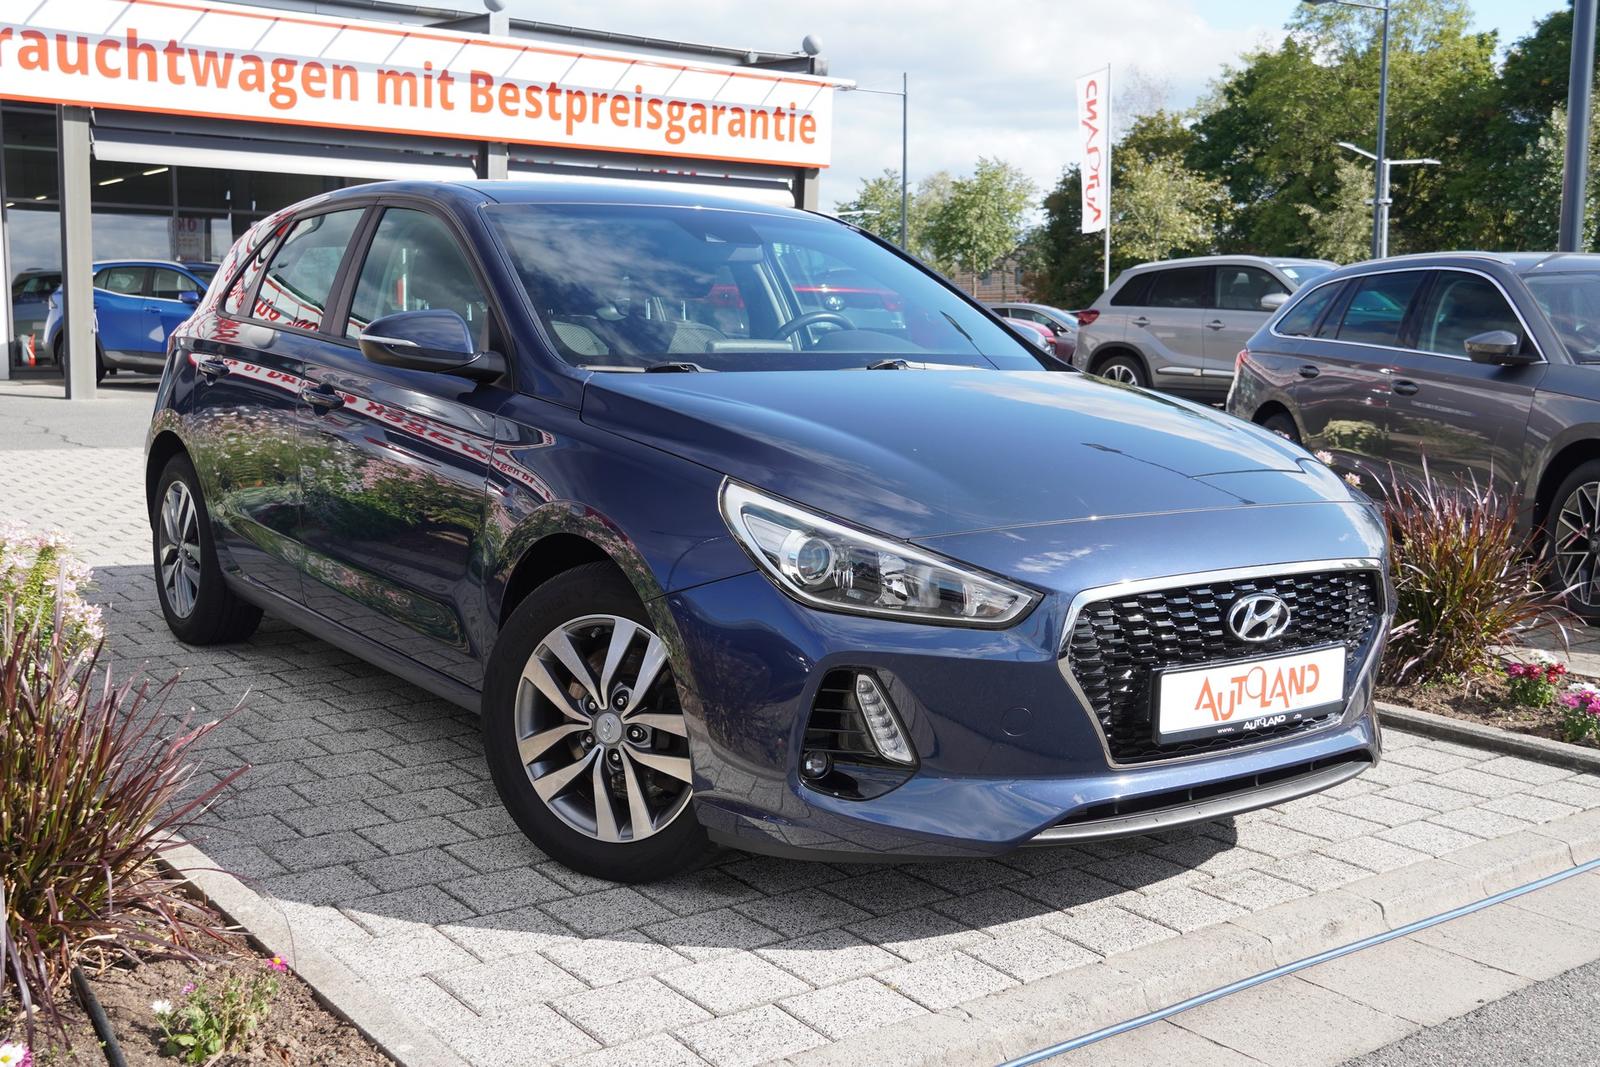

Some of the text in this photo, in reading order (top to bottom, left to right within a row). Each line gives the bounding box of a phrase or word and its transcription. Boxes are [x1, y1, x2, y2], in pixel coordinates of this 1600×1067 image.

[377, 61, 455, 110] mit
[470, 70, 817, 146] Bestpreisgarantie
[1194, 663, 1320, 721] AUTOLAND
[1243, 715, 1286, 730] AUTOLAND
